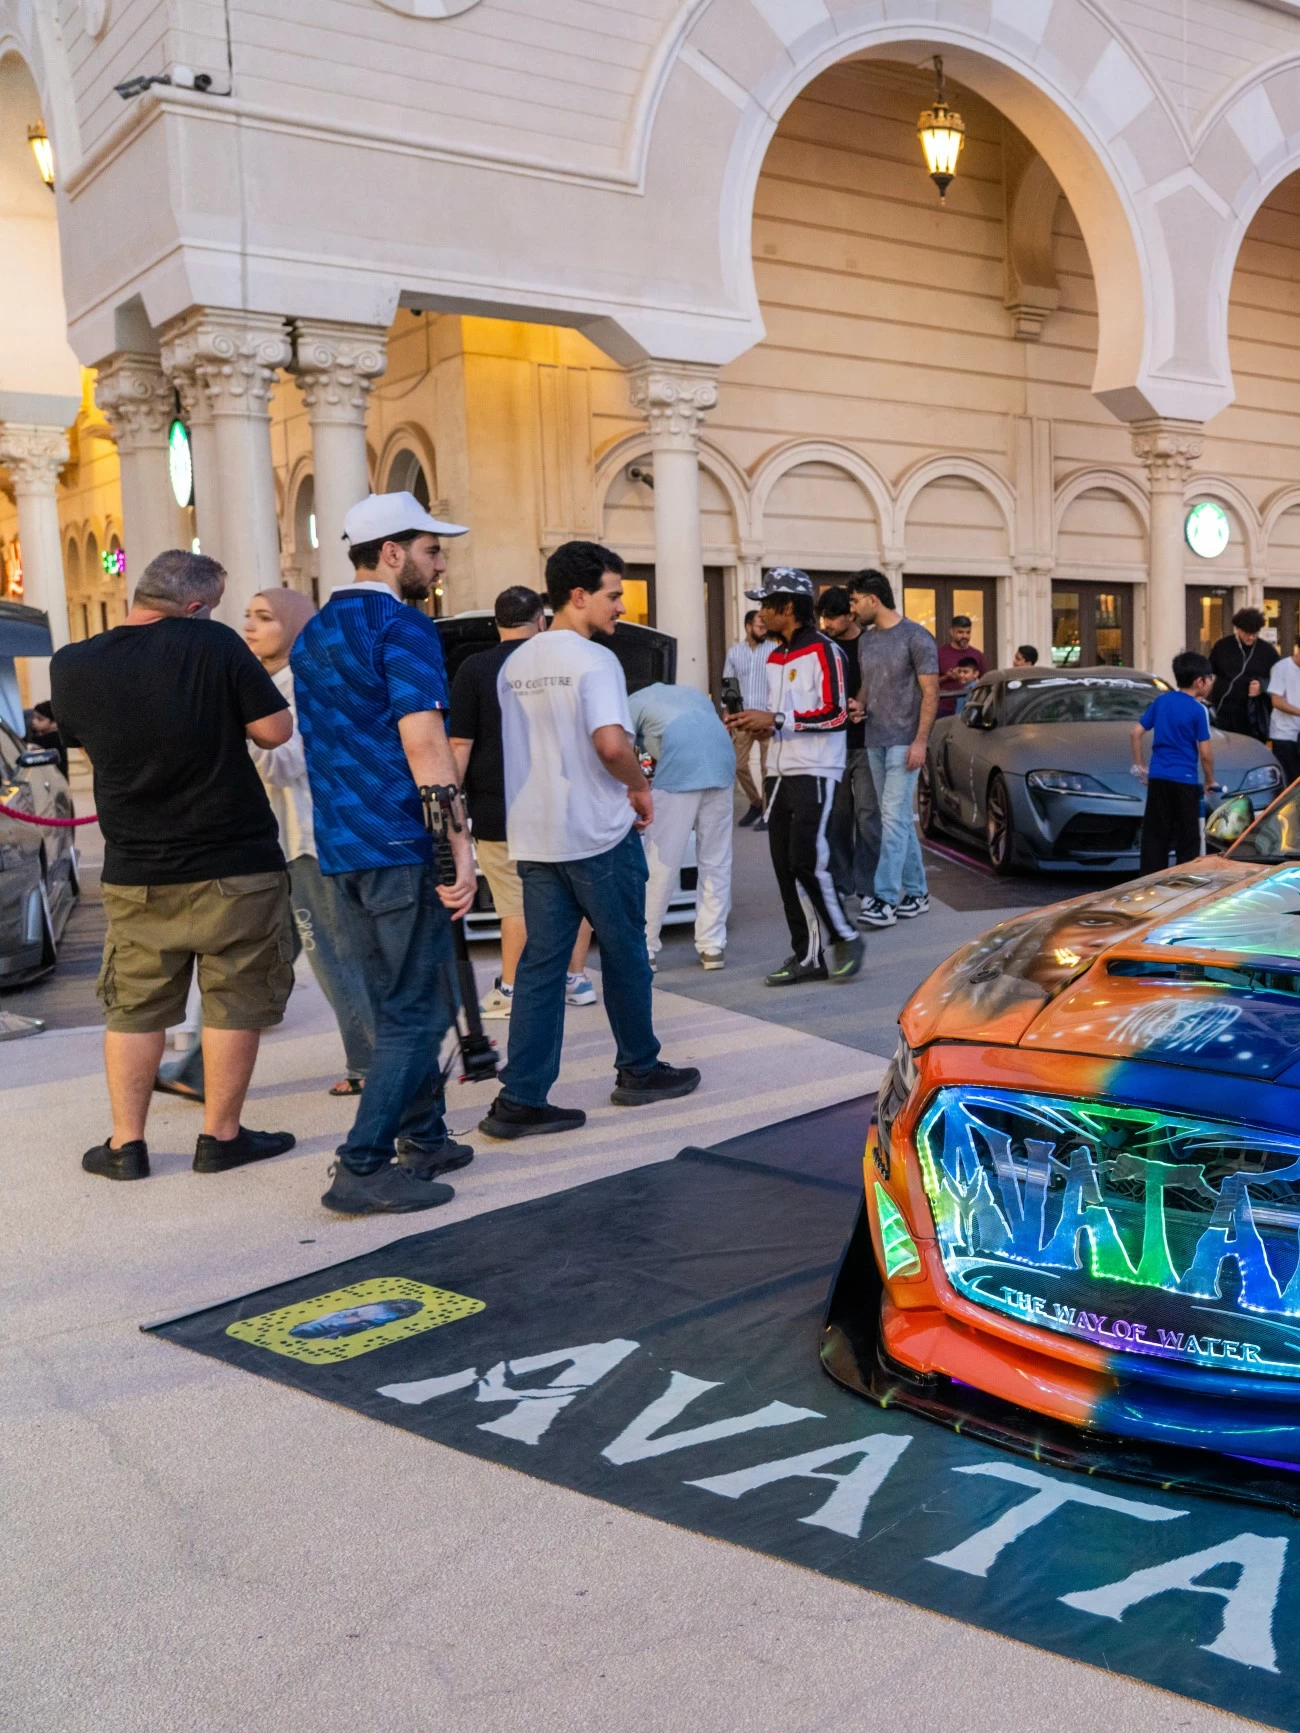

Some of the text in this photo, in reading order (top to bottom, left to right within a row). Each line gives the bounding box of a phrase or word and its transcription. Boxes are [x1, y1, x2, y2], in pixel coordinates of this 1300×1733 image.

[1000, 1286, 1262, 1363] THE WAY OF WATER
